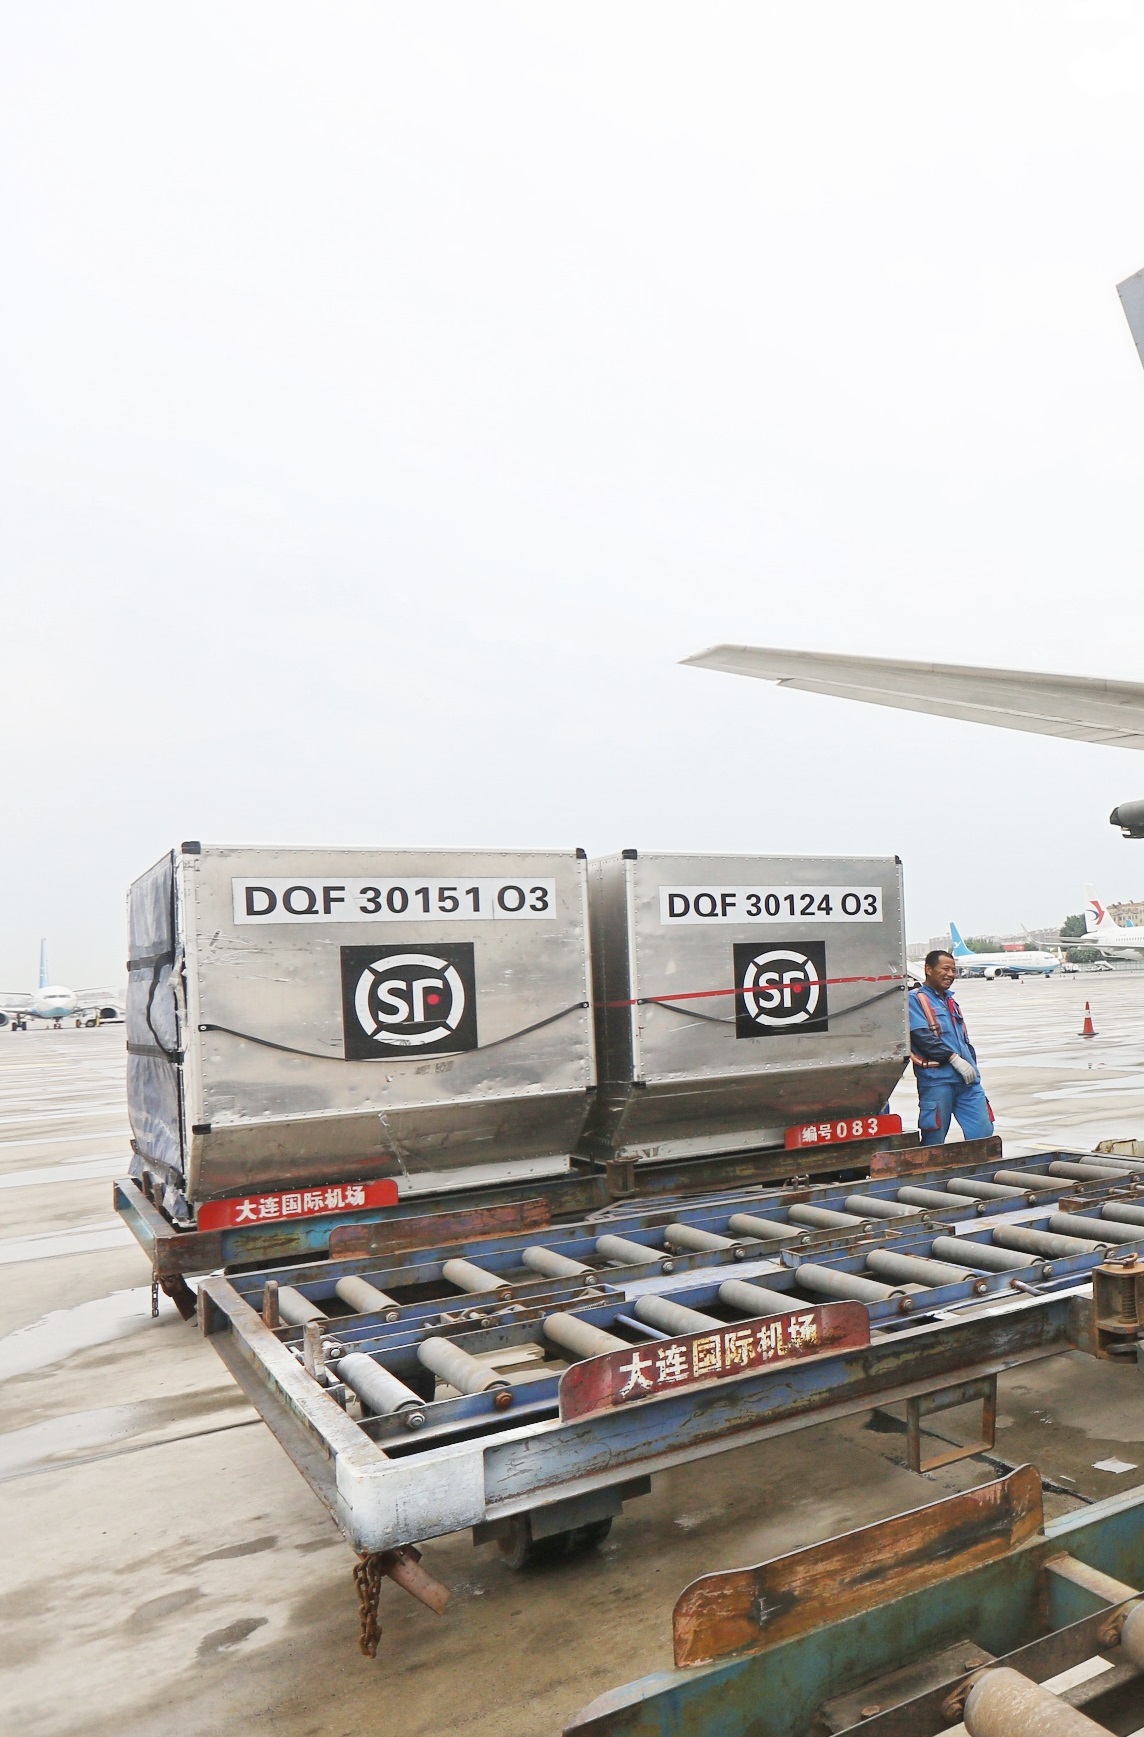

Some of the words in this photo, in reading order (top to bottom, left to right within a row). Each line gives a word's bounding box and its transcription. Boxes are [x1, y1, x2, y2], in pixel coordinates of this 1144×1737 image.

[246, 886, 346, 916] DQF
[360, 887, 480, 914] 30151
[669, 893, 737, 917] DQF
[746, 894, 833, 917] 30124
[235, 1185, 366, 1222] 大连国际机场
[619, 1313, 819, 1399] 大连国际机场
